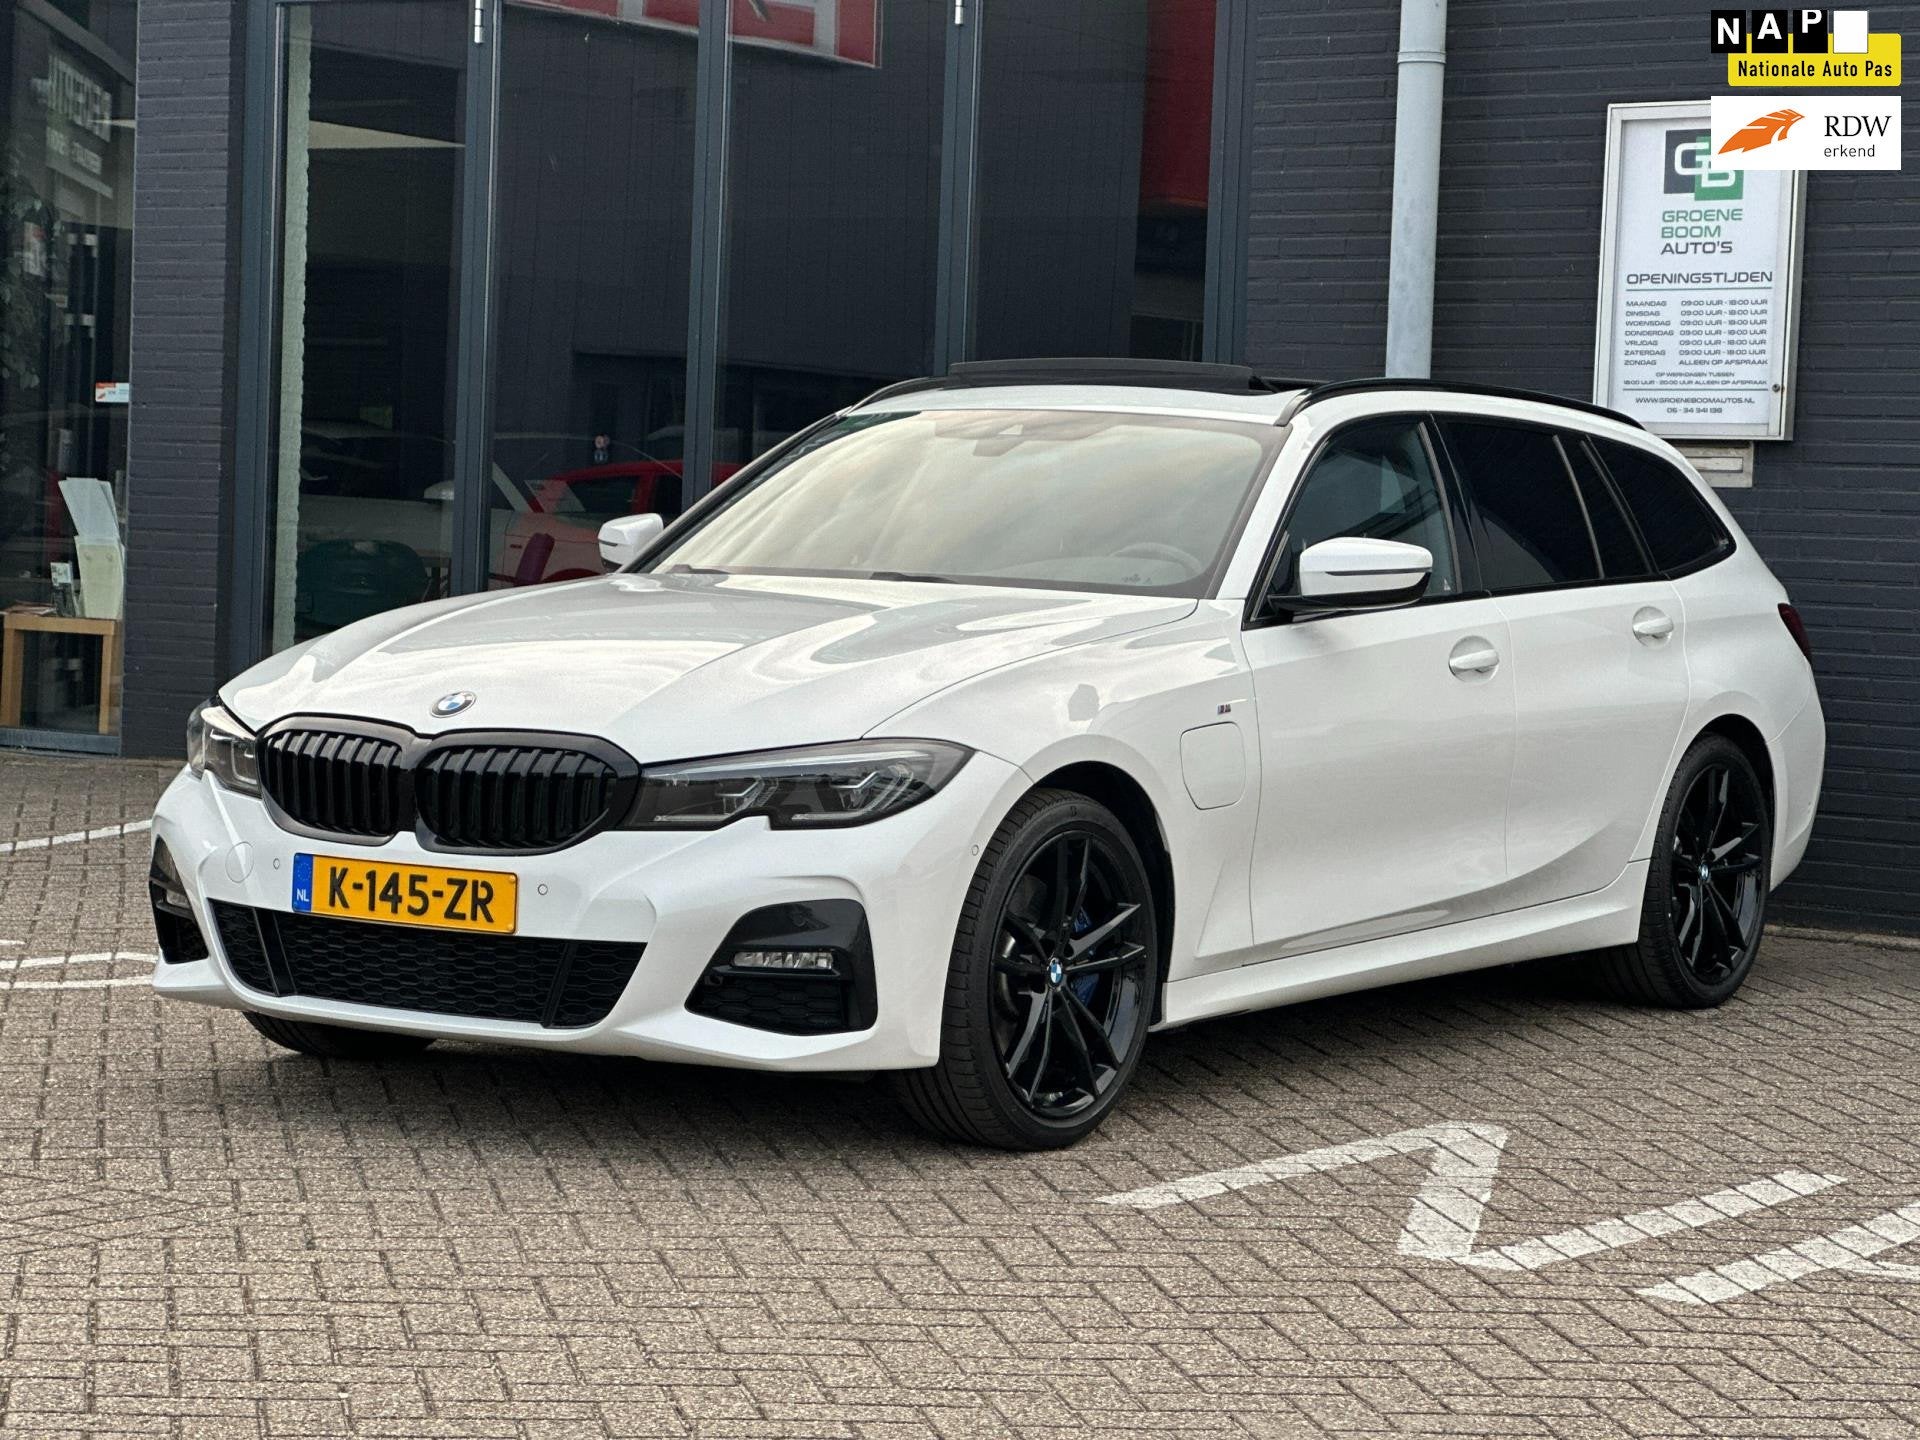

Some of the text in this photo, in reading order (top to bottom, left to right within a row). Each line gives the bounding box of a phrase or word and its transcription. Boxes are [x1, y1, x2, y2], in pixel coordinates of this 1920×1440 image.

[1662, 209, 1743, 222] GROENE
[1661, 226, 1721, 239] BOOM
[1660, 241, 1733, 255] AUTO'S
[1626, 271, 1773, 285] OPENINGSTIJDEN
[296, 888, 310, 902] NL
[328, 866, 494, 923] K-145-ZR
